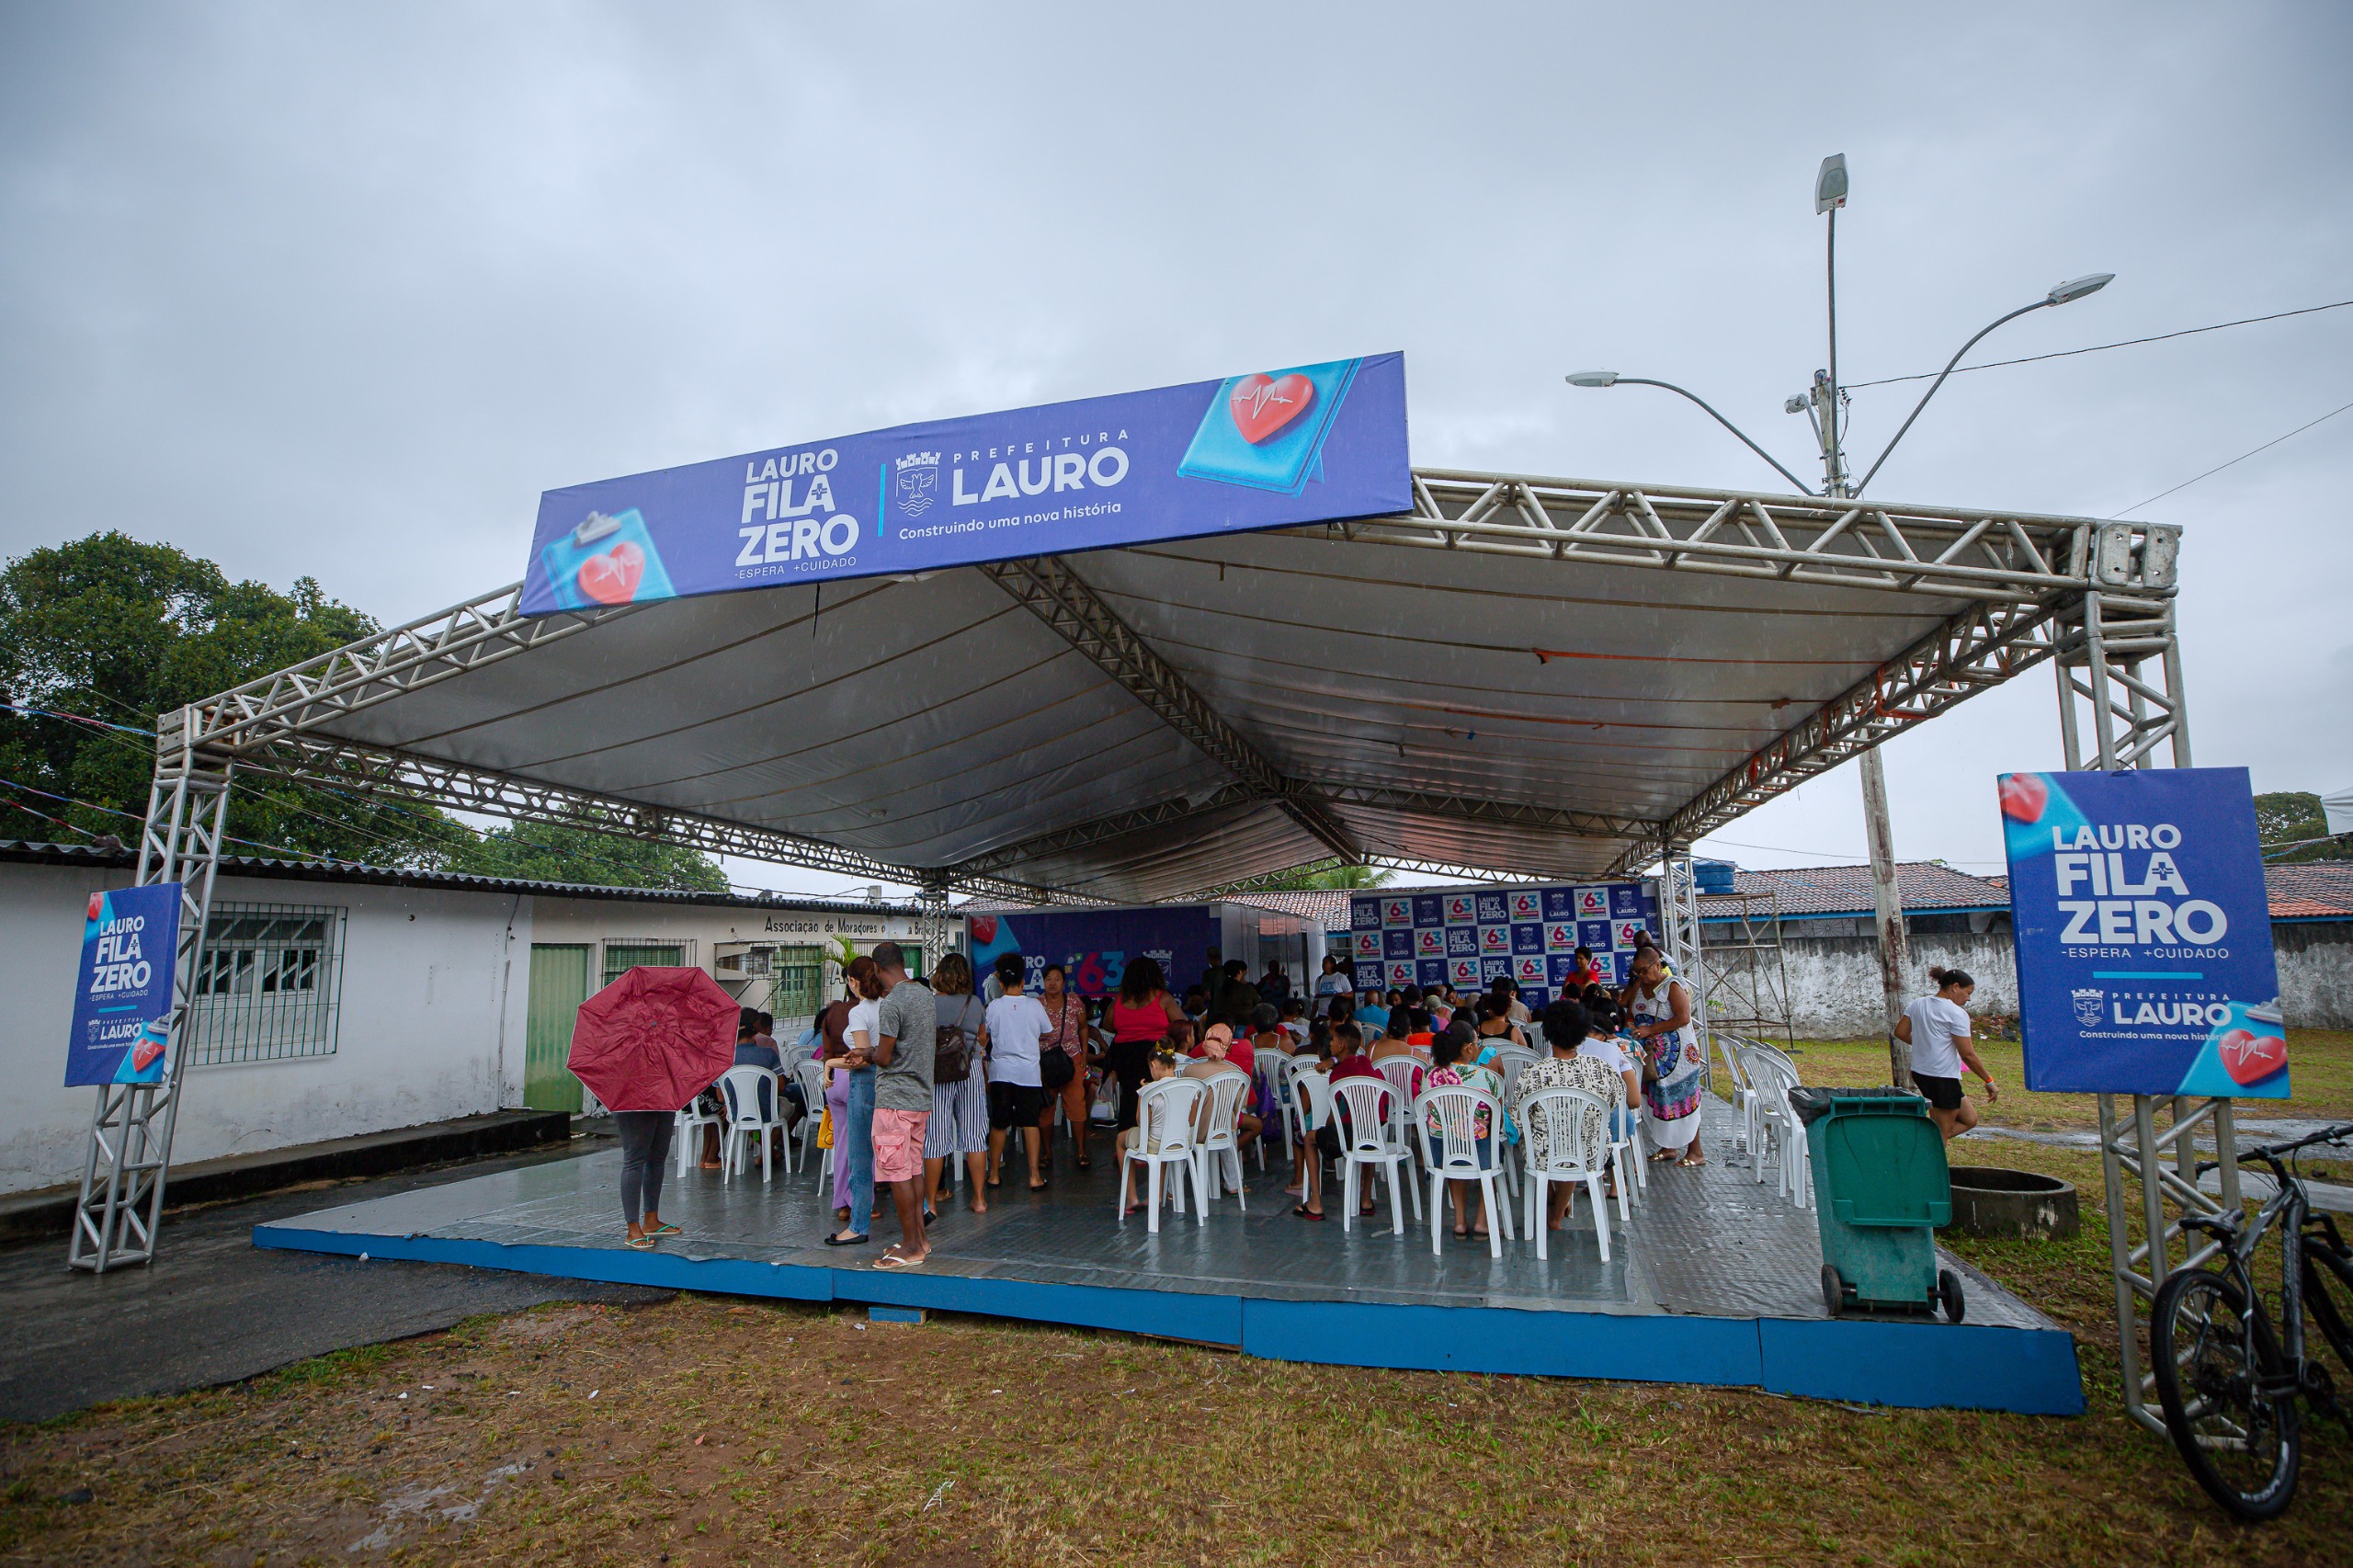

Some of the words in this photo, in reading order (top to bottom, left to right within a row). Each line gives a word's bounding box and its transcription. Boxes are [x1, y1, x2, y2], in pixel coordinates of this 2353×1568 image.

[953, 429, 1129, 463] PREFEITURA
[745, 448, 838, 484] LAURO
[952, 446, 1130, 506] LAURO
[741, 473, 835, 524] FILA
[899, 518, 985, 540] Construindo
[988, 517, 1020, 529] uma
[1024, 512, 1060, 525] nova
[1063, 502, 1121, 519] história
[735, 514, 859, 567] ZERO
[733, 565, 785, 579] -ESPERA
[793, 556, 857, 572] +CUIDADO
[2052, 824, 2182, 851] LAURO
[2054, 852, 2189, 896] FILA
[1452, 898, 1472, 914] 63
[1479, 902, 1501, 911] FILA
[1517, 895, 1538, 911] 63
[1584, 892, 1605, 907] 63
[1354, 909, 1374, 917] FILA
[1390, 902, 1409, 917] 63
[1479, 910, 1506, 919] ZERO
[100, 915, 145, 937] LAURO
[764, 915, 819, 936] Associação
[824, 919, 834, 933] de
[837, 917, 878, 936] Moradores
[1354, 916, 1380, 926] ZERO
[2057, 899, 2228, 945] ZERO
[1360, 934, 1380, 949] 63
[1423, 931, 1442, 947] 63
[1449, 935, 1471, 944] FILA
[1487, 928, 1507, 944] 63
[1552, 926, 1574, 941] 63
[96, 933, 142, 964] FILA
[1449, 943, 1477, 953] ZERO
[2061, 948, 2131, 959] -ESPERA
[2143, 948, 2229, 959] +CUIDADO
[1078, 950, 1124, 993] 63
[1393, 963, 1414, 980] 63
[1457, 960, 1477, 977] 63
[1483, 965, 1506, 974] FILA
[1522, 959, 1543, 974] 63
[1590, 956, 1611, 972] 63
[90, 960, 152, 993] ZERO
[1357, 970, 1378, 979] FILA
[1357, 978, 1383, 987] ZERO
[2112, 993, 2230, 1001] PREFEITURA
[2113, 1002, 2233, 1027] LAURO
[100, 1022, 142, 1040] LAURO
[2079, 1030, 2139, 1040] Construindo
[2190, 1032, 2230, 1040] história
